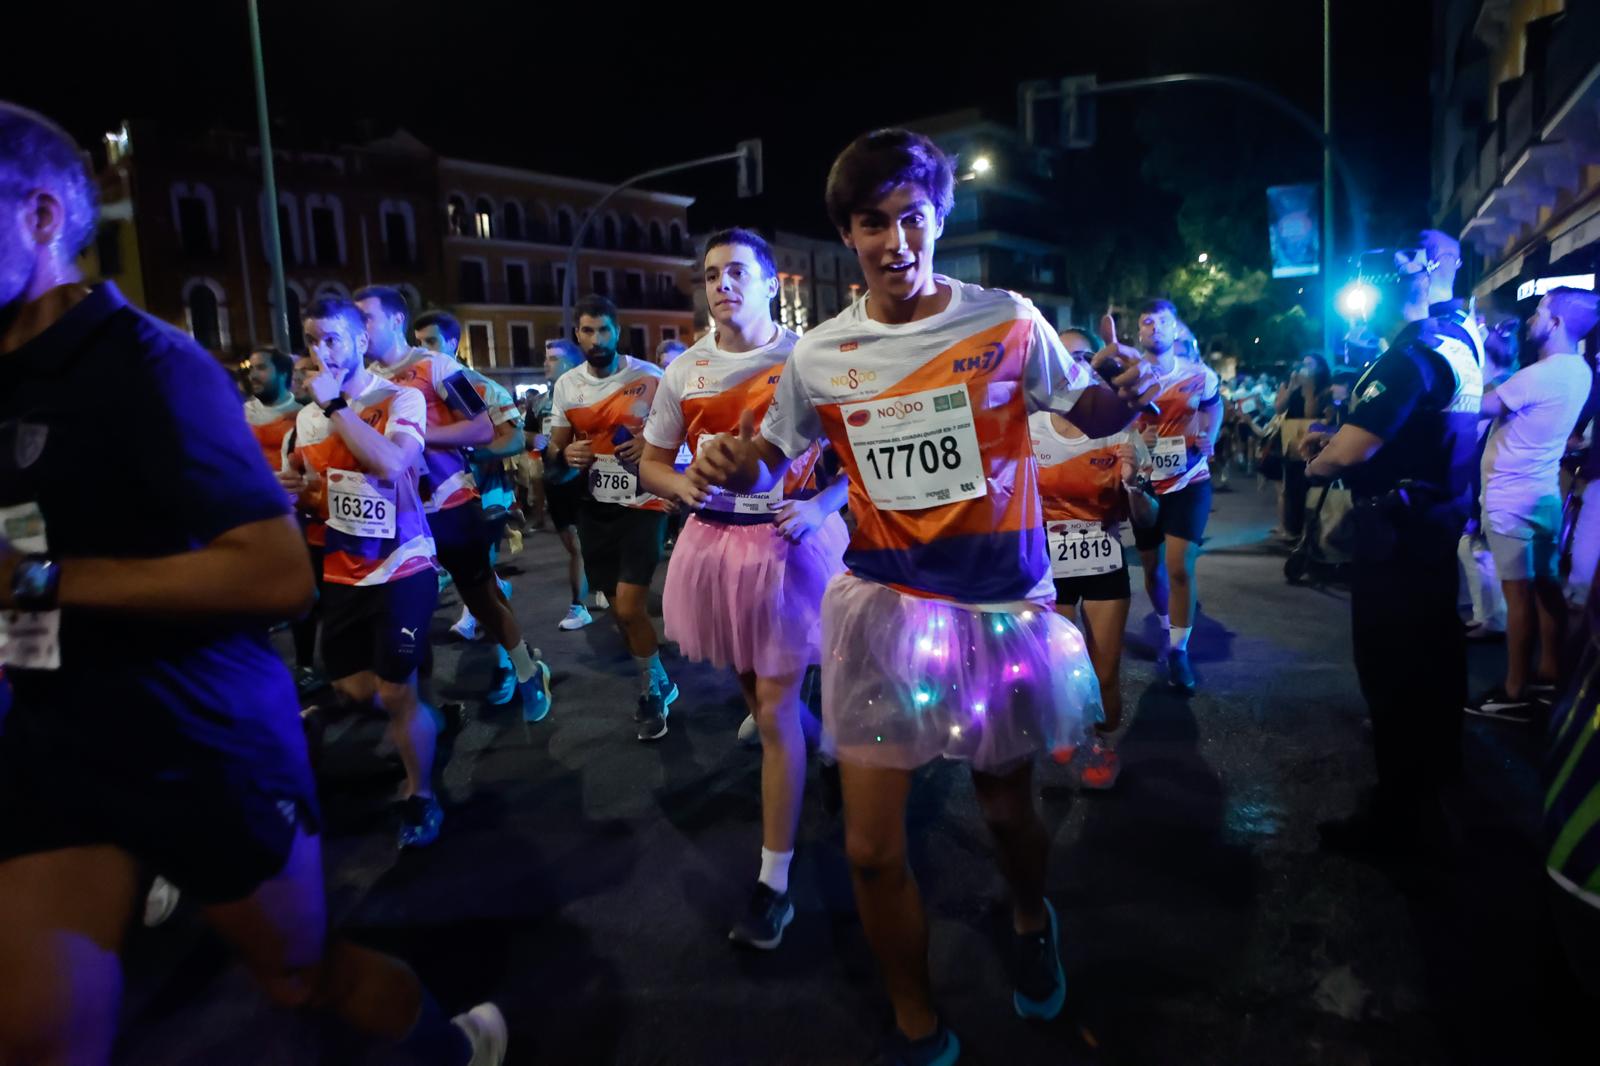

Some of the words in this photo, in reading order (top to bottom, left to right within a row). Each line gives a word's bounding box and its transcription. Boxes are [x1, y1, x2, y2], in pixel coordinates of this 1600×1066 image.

[867, 435, 962, 480] 17708
[334, 495, 385, 520] 16326
[1058, 539, 1111, 561] 21819
